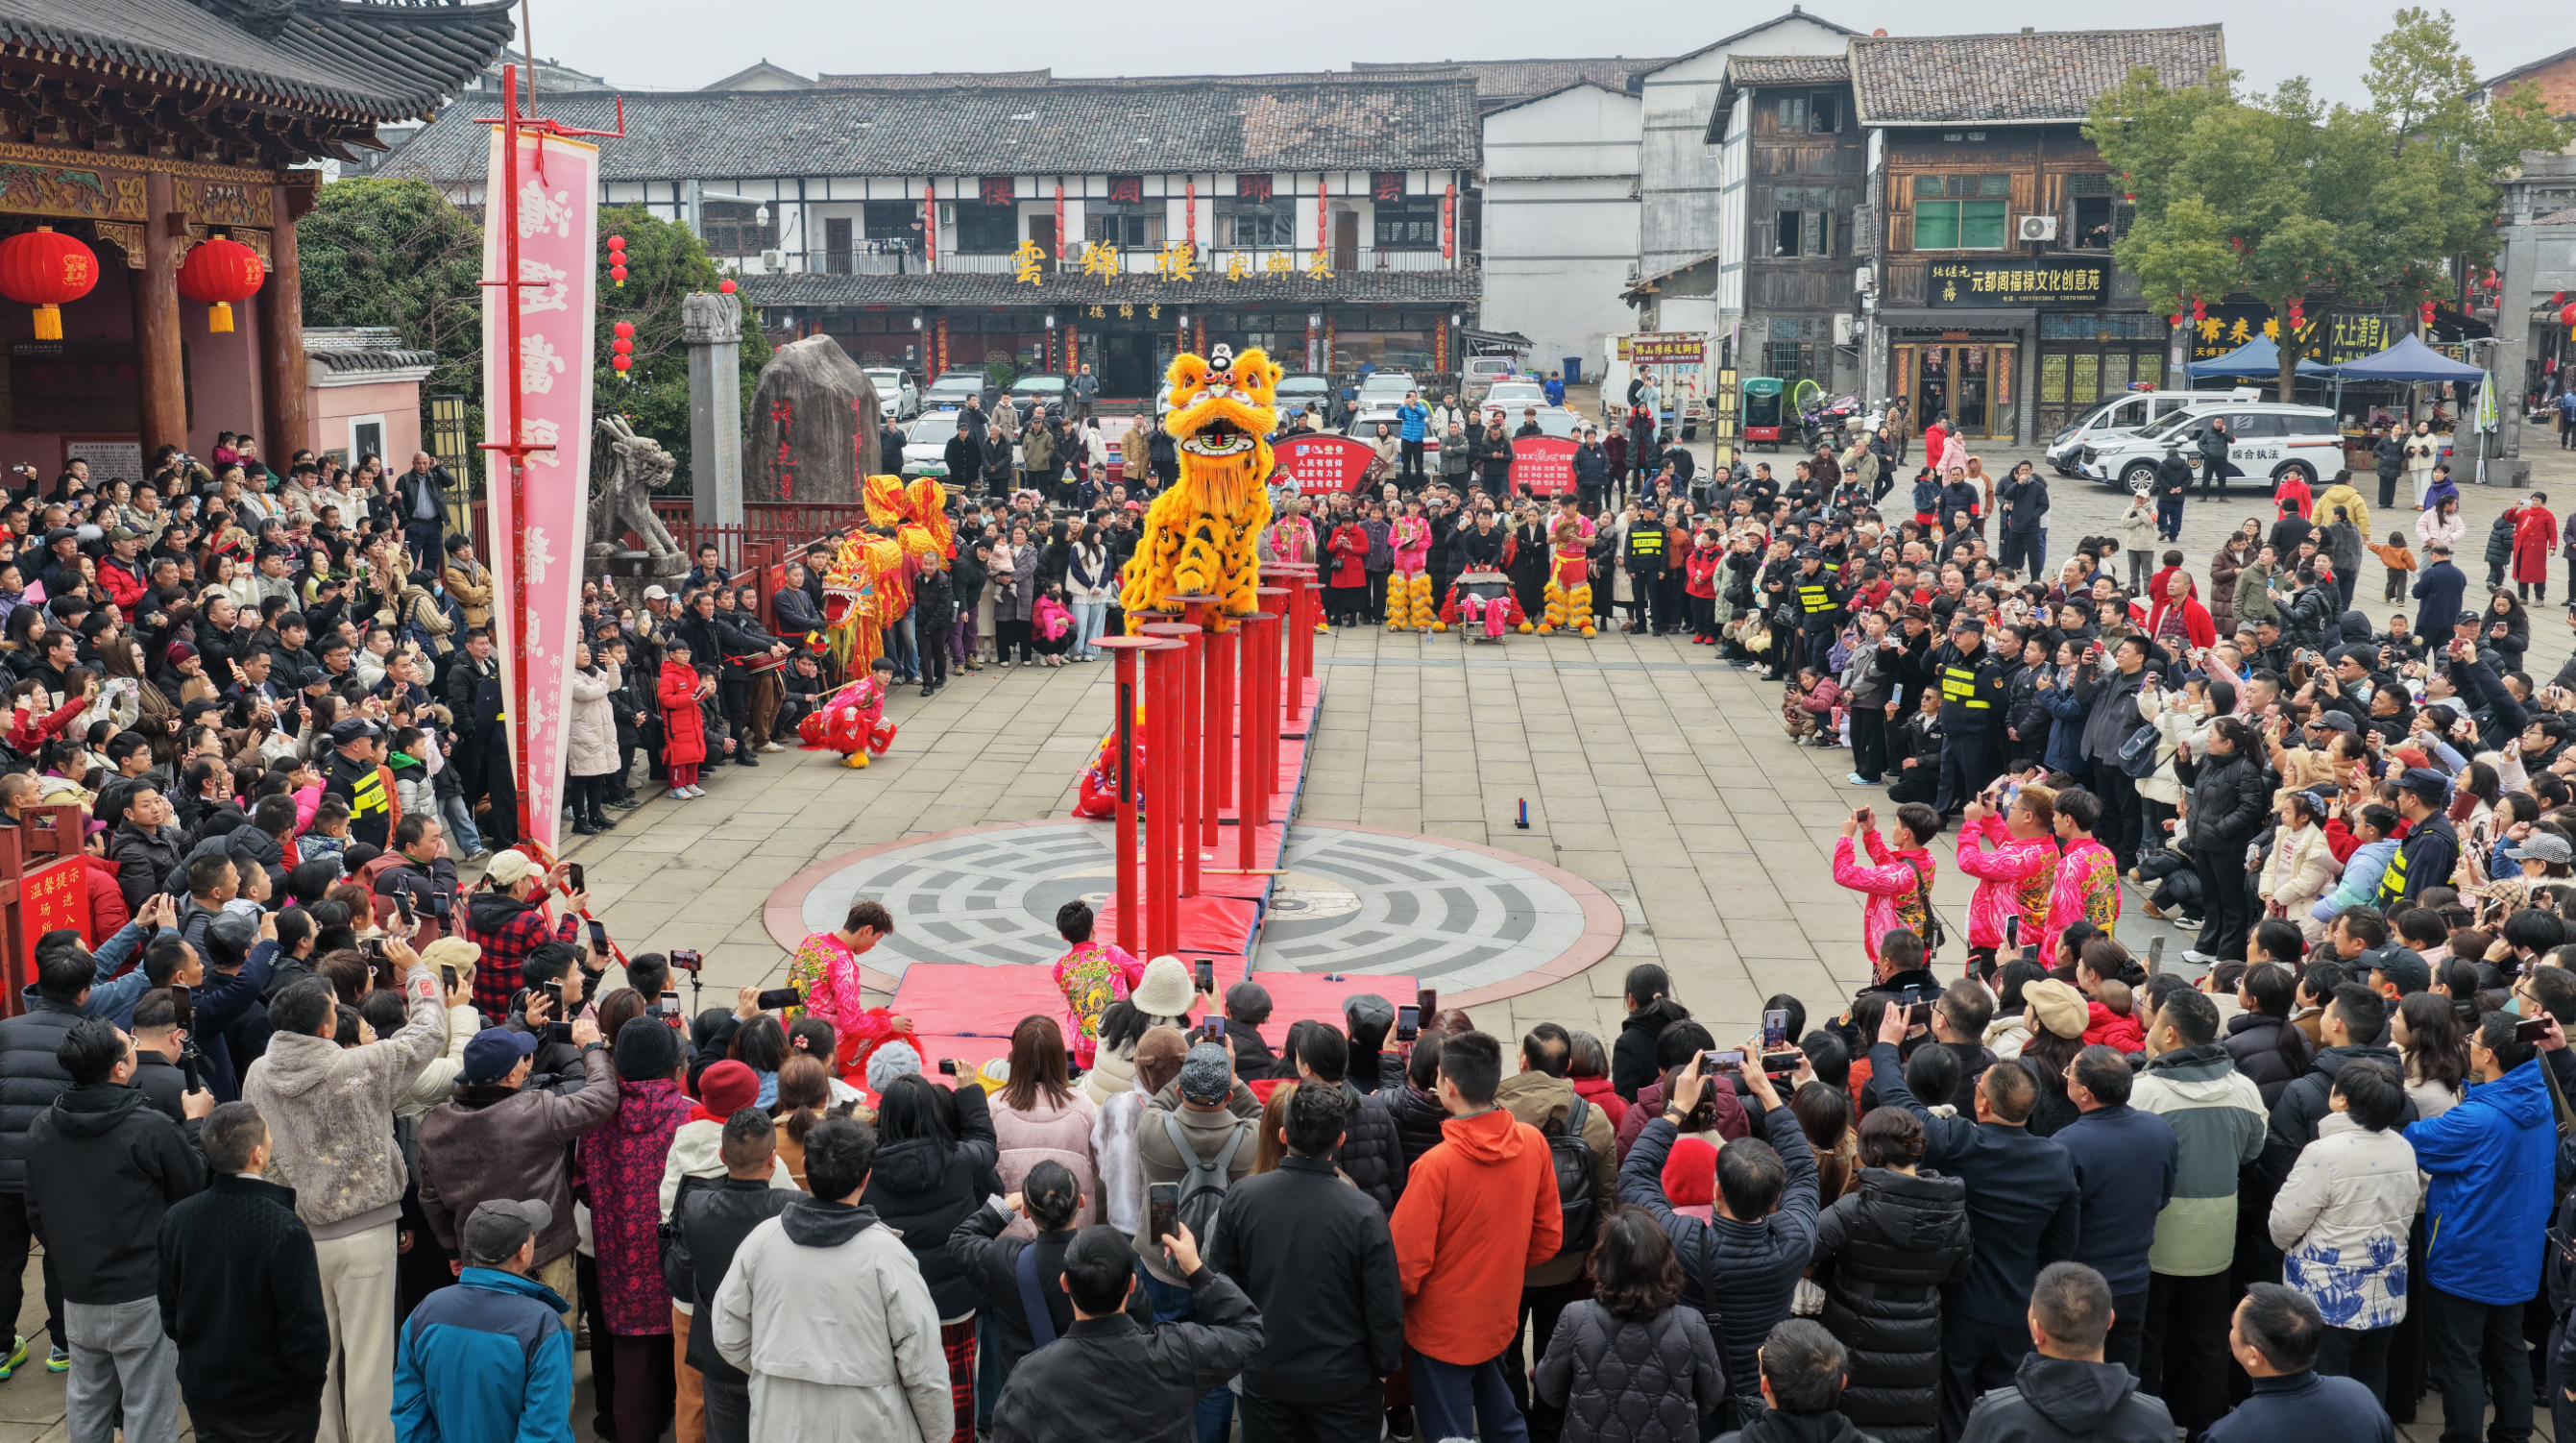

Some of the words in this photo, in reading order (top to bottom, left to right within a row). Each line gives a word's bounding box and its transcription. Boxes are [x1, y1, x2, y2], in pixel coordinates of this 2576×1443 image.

[1971, 268, 2102, 293] 元都阁福禄文化创意苑
[2333, 315, 2381, 348] 大上清宫
[1298, 458, 1343, 467] 人民有信仰
[2230, 449, 2279, 460] 综合执法
[1298, 469, 1343, 477] 国家有力量
[1298, 479, 1343, 488] 民族有希望
[30, 867, 80, 900] 温馨提示
[61, 893, 76, 927] 进入
